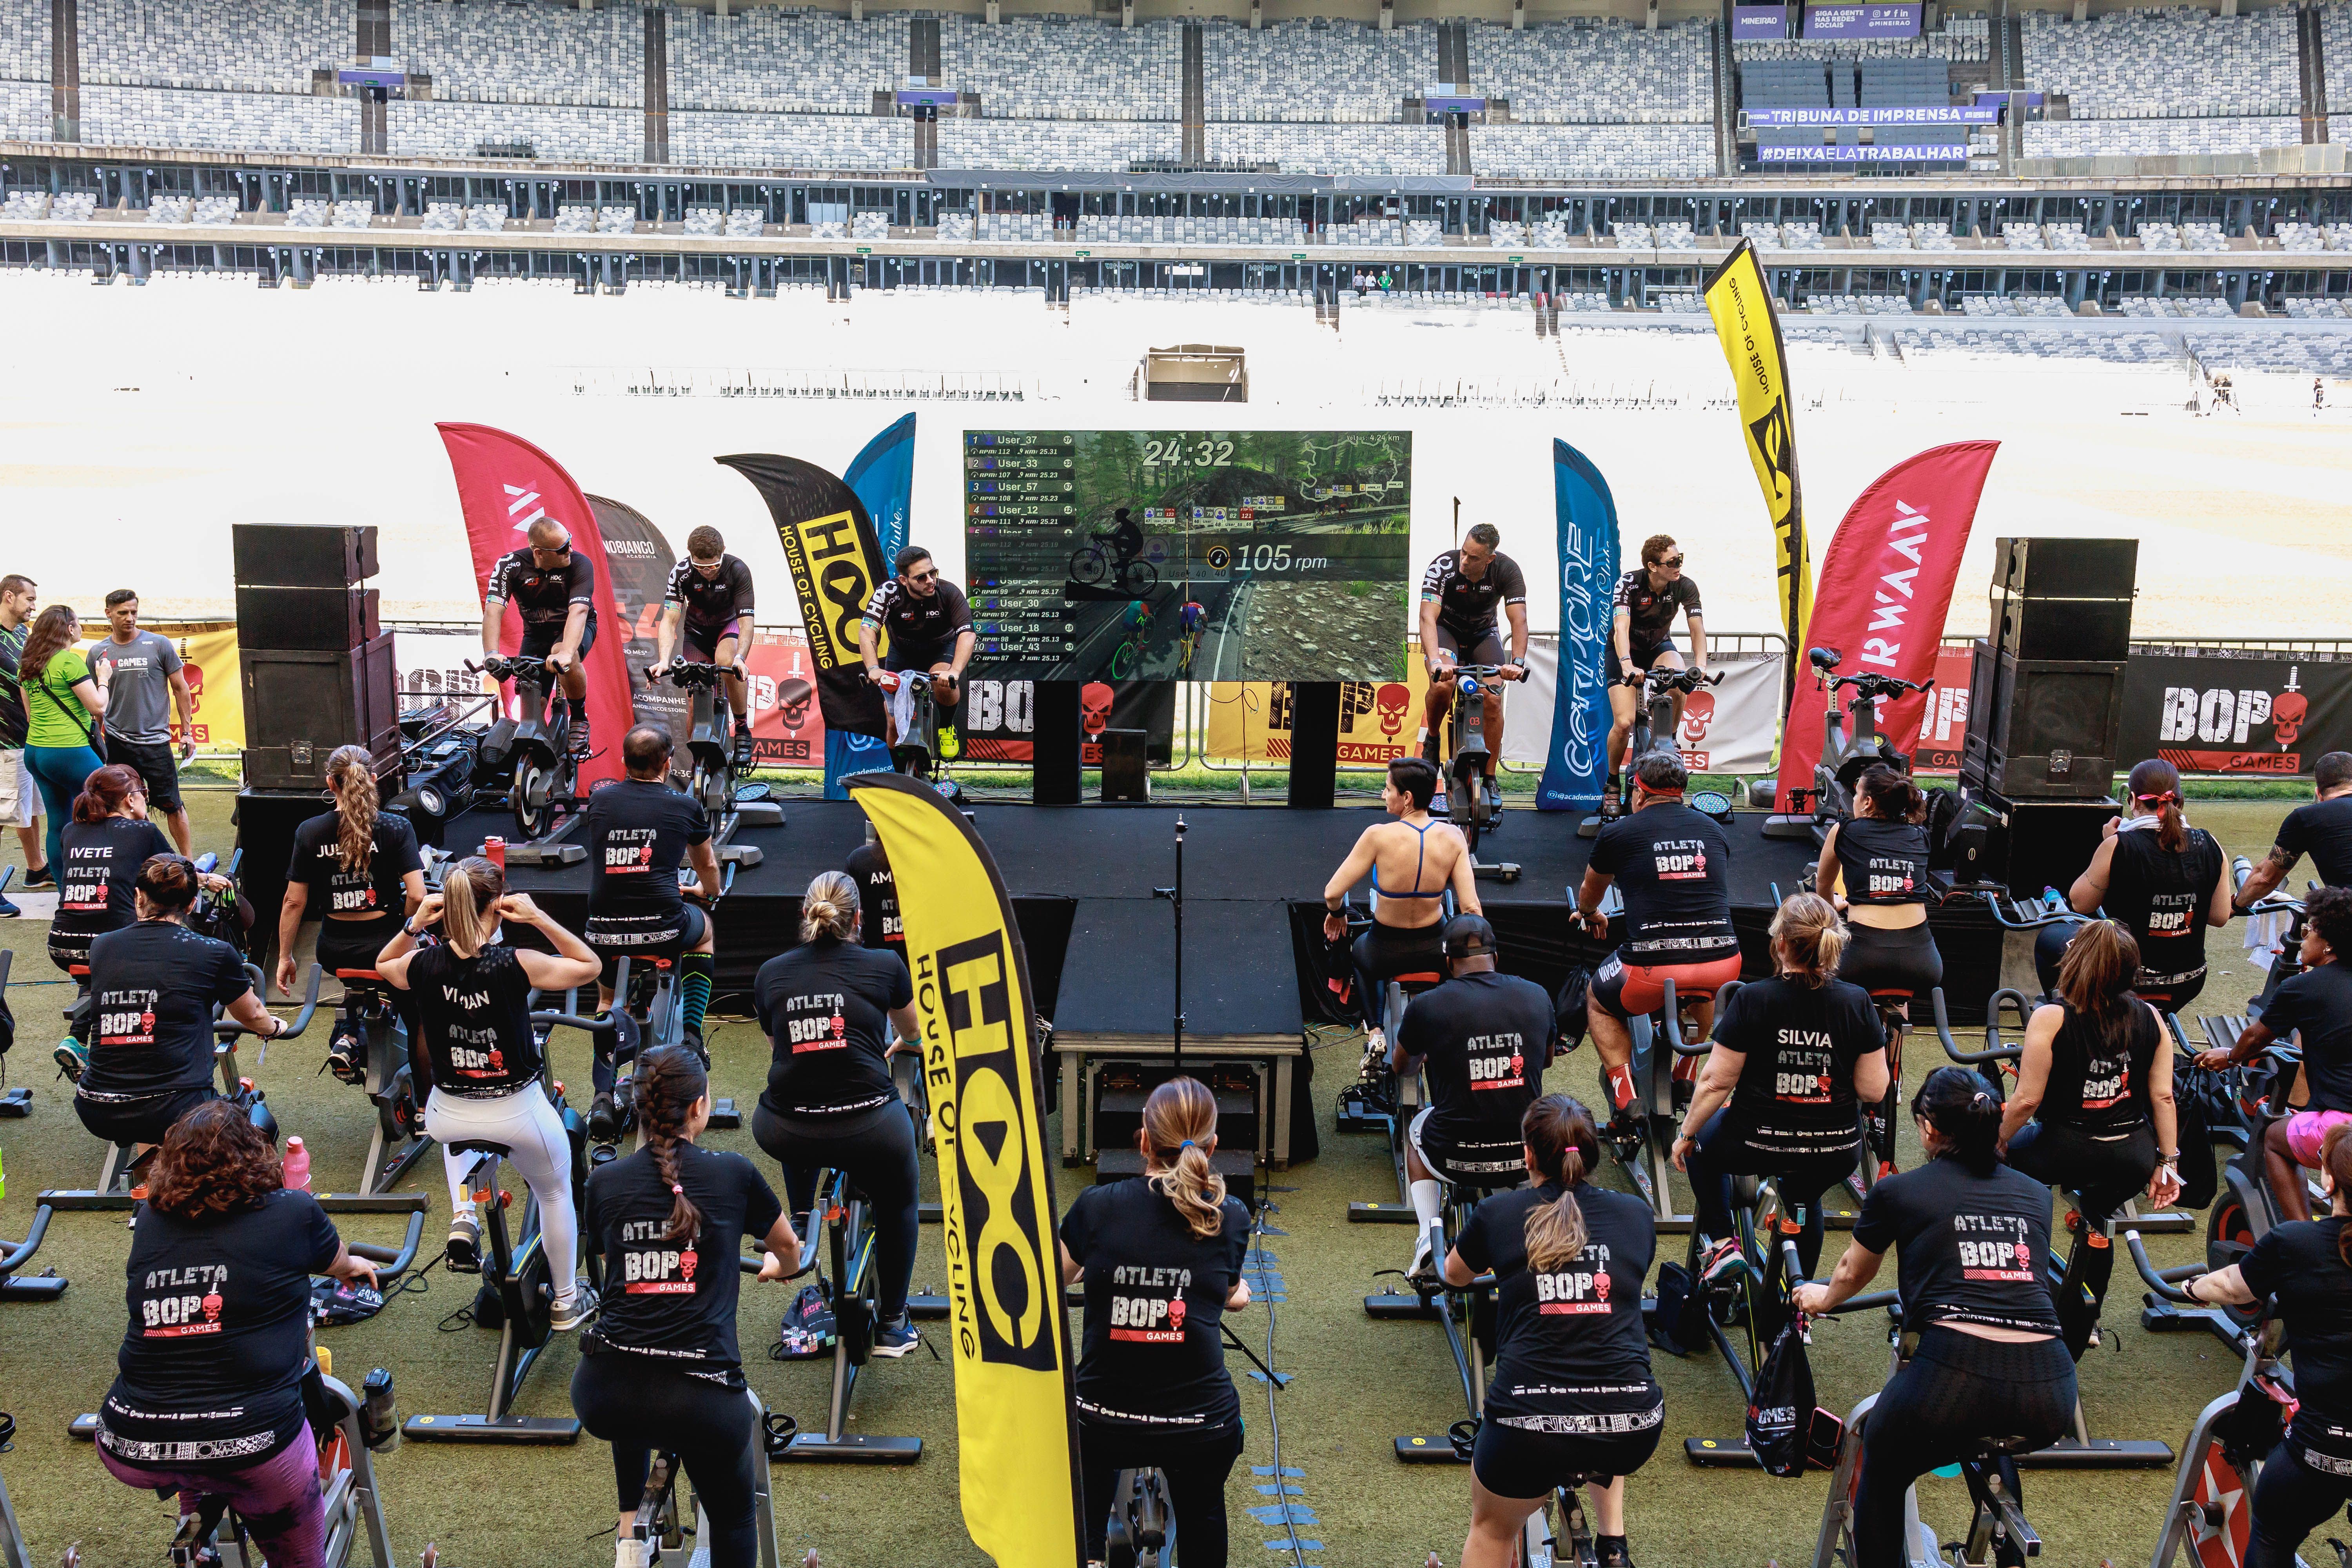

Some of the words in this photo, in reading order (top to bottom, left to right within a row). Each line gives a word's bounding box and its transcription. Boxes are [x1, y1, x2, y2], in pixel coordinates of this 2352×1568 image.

[1771, 110, 1844, 122] TRIBUNA
[1848, 110, 1869, 122] DE
[1873, 109, 1961, 122] IMPRENSA
[1762, 147, 1964, 160] #DEIXAELATRABALHAR
[1729, 277, 1748, 330] CYCLING
[1744, 334, 1754, 351] OF
[1749, 352, 1769, 395] HOUSE
[998, 437, 1037, 446] User_37
[1142, 441, 1234, 467] 24:32
[998, 460, 1037, 469] User_33
[998, 483, 1037, 492] User_57
[999, 506, 1038, 515] User_12
[1235, 545, 1292, 571] 105
[1296, 555, 1327, 571] rpm
[1423, 556, 1453, 591] HOC
[780, 525, 805, 574] HOUSE
[796, 579, 811, 598] OF
[804, 602, 833, 670] CYCLING
[866, 580, 897, 617] HOC
[1000, 600, 1039, 608] User_30
[1000, 624, 1039, 633] User_18
[1001, 643, 1040, 652] User_43
[118, 657, 148, 667] GAMES
[633, 693, 687, 705] ACOMPANHE
[2160, 687, 2272, 743] BOP
[752, 740, 807, 758] AMES
[1338, 746, 1402, 761] GAMES
[2230, 755, 2296, 769] GAMES
[608, 828, 657, 841] ATLETA
[71, 847, 113, 859] IVETE
[1653, 840, 1705, 852] ATLETA
[606, 847, 640, 865] BOP
[1656, 855, 1694, 872] BOP
[1869, 857, 1914, 872] ATLETA
[67, 867, 110, 878] ATLETA
[1869, 875, 1904, 891] BOP
[65, 884, 96, 902] BOP
[333, 889, 366, 909] BOP
[2152, 893, 2197, 905] ATLETA
[2149, 912, 2185, 929] BOP
[1599, 957, 1622, 983] STRAVA
[101, 989, 158, 1005] ATLETA
[787, 993, 844, 1011] ATLETA
[100, 1013, 141, 1035] BOP
[788, 1017, 831, 1042] BOP
[449, 1024, 497, 1044] ATLETA
[1468, 1033, 1523, 1051] ATLETA
[1777, 1029, 1833, 1048] SILVIA
[818, 1039, 846, 1049] GAMES
[451, 1047, 489, 1069] BOP
[1778, 1050, 1831, 1067] ATLETA
[482, 1069, 509, 1077] GAMES
[1469, 1057, 1510, 1080] BOP
[1497, 1079, 1523, 1088] GAMES
[1776, 1073, 1818, 1094] BOP
[916, 954, 951, 1087] HOUSE
[949, 1175, 975, 1359] YCLING
[1954, 1215, 2028, 1234] ATLETA
[1958, 1241, 2015, 1267] BOP
[625, 1251, 679, 1281] BOP
[145, 1265, 227, 1289] ATLETA
[1113, 1265, 1191, 1287] ATLETA
[2000, 1271, 2032, 1280] GAMES
[659, 1283, 694, 1292] GAMES
[1536, 1272, 1593, 1301] BOP
[142, 1295, 201, 1327] BOP
[803, 1302, 822, 1318] BOP
[1111, 1296, 1167, 1327] BOP
[181, 1323, 219, 1334] GAMES
[1147, 1332, 1182, 1341] GAMES
